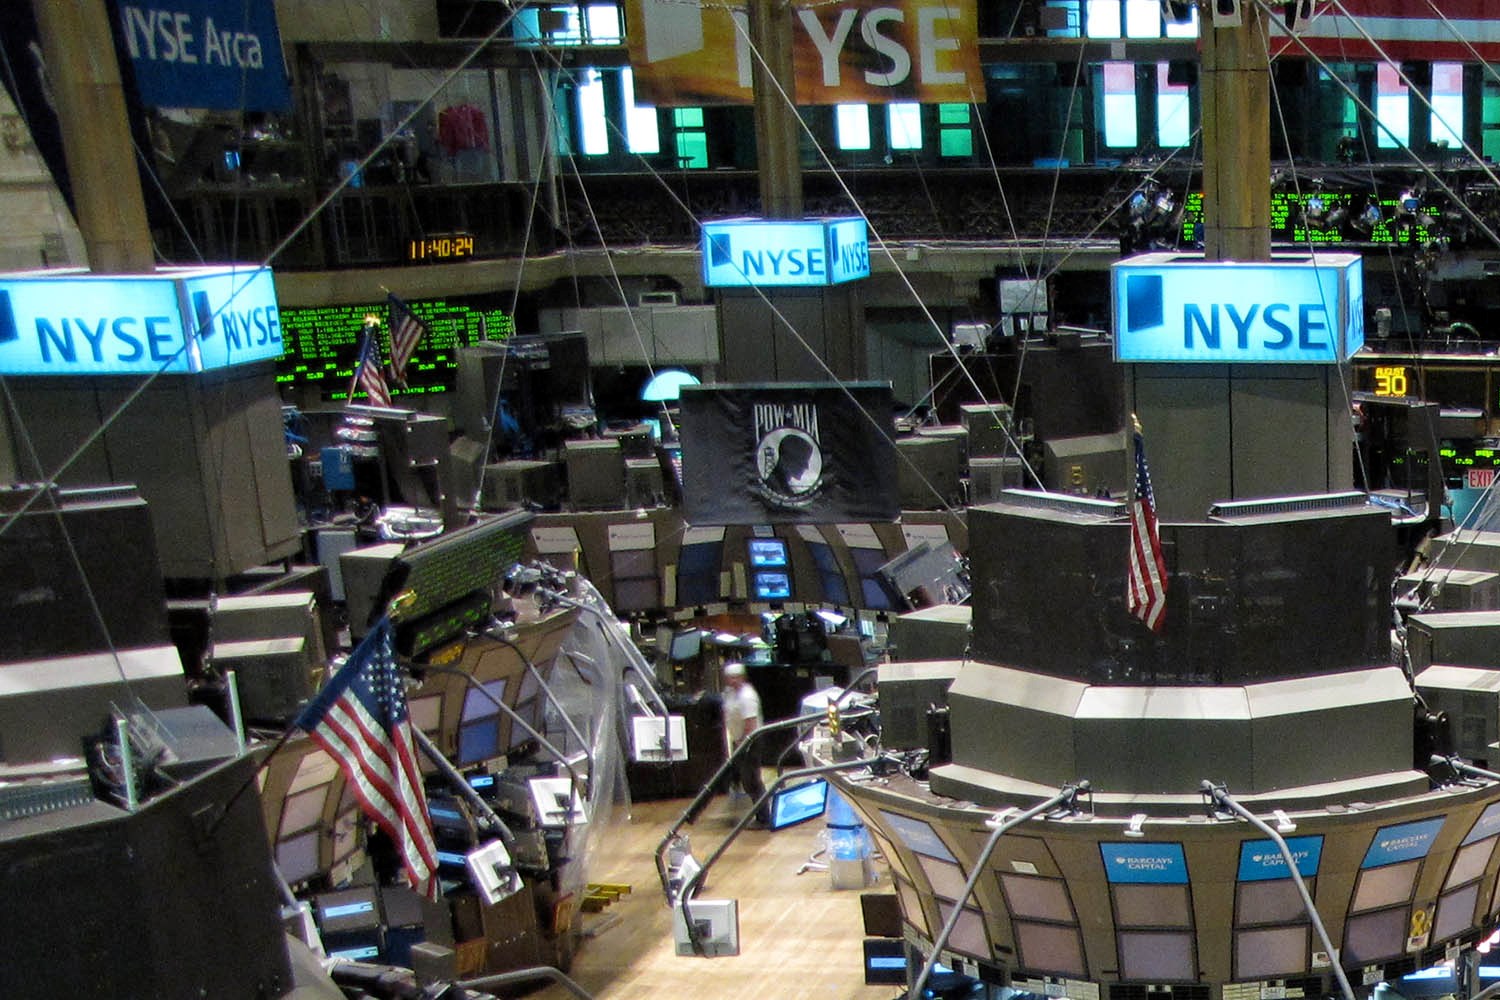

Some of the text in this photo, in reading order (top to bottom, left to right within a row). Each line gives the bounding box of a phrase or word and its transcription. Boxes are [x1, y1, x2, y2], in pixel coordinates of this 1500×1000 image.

[206, 17, 264, 69] Arca
[412, 237, 473, 259] 11:40:24
[742, 248, 825, 276] NYSE
[841, 241, 868, 274] NYSE
[35, 316, 175, 363] NYSE
[221, 305, 281, 351] NYSE
[1183, 303, 1328, 350] NYSE
[1375, 375, 1406, 395] 30
[754, 403, 820, 443] POW MIA
[1469, 471, 1494, 488] EXIT
[1127, 857, 1174, 865] BARCLAYS
[1128, 863, 1168, 871] CAPITAL
